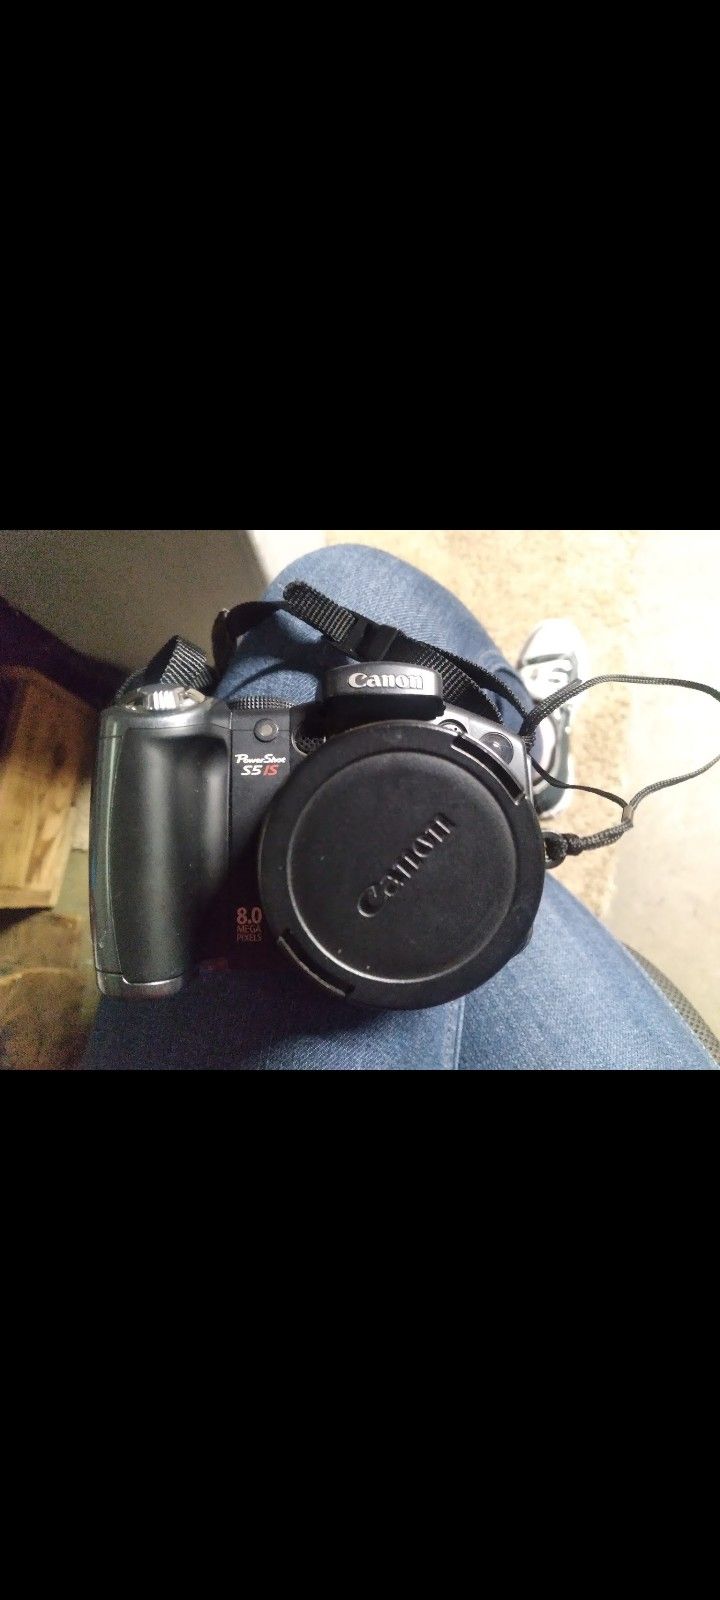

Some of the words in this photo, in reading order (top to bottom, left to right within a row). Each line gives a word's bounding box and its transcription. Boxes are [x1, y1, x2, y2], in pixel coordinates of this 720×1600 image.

[348, 672, 424, 690] Canon
[235, 753, 287, 764] PowerShot
[241, 765, 263, 776] S5
[263, 764, 280, 776] IS
[357, 812, 456, 917] Canon
[236, 907, 263, 924] 8.0
[236, 924, 262, 933] MEGA
[236, 933, 263, 942] PIXELS
